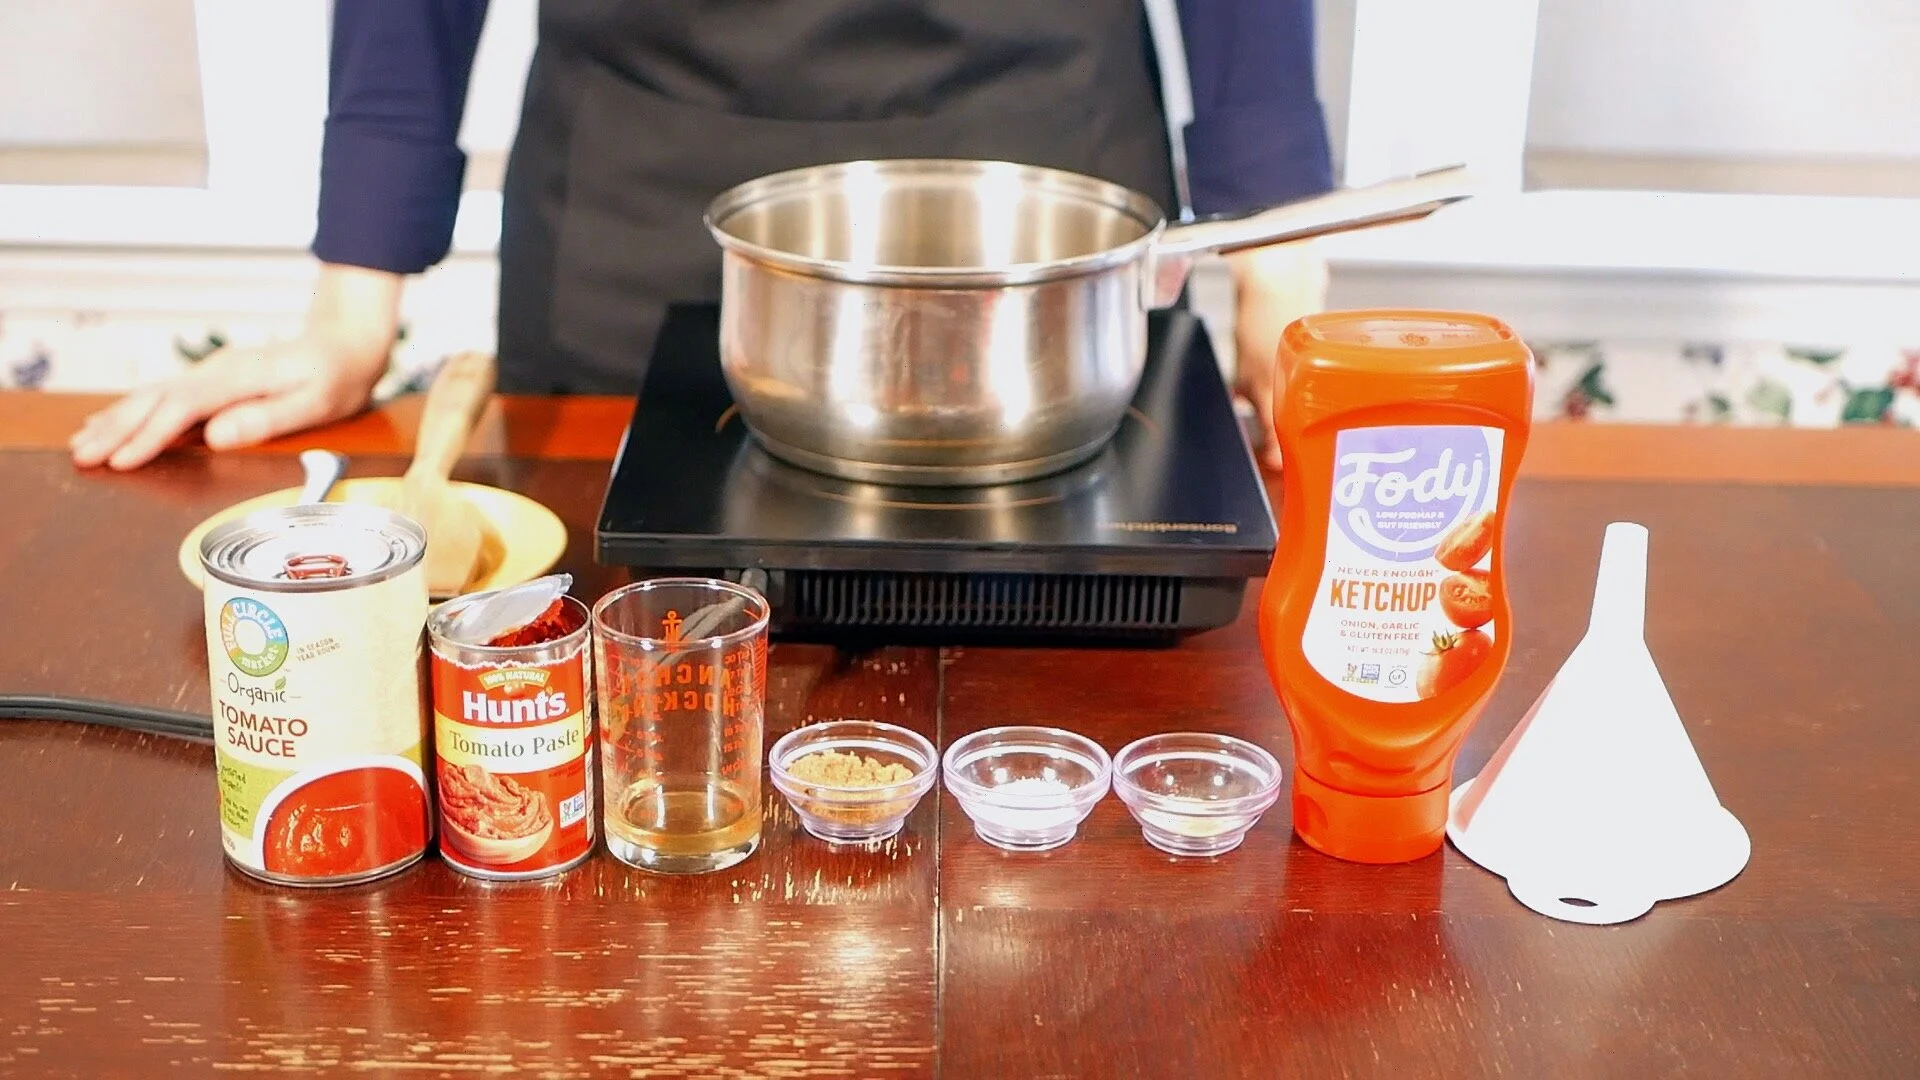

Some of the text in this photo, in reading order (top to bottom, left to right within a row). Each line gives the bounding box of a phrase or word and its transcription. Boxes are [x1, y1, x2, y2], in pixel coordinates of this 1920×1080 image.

[1334, 448, 1484, 508] Fody
[1377, 521, 1397, 530] GUT
[1338, 566, 1380, 578] NEVER
[1330, 578, 1437, 612] KETCHUP
[231, 602, 284, 641] CIRCLE
[1339, 629, 1421, 641] & GLUTEN FREE
[1340, 619, 1420, 631] ONION, GARLIC
[227, 671, 288, 706] Organic
[505, 670, 545, 683] NATURAL
[218, 699, 309, 737] TOMATO
[462, 687, 567, 723] Hunt's
[227, 725, 297, 758] SAUCE
[449, 728, 580, 758] Tomato Paste
